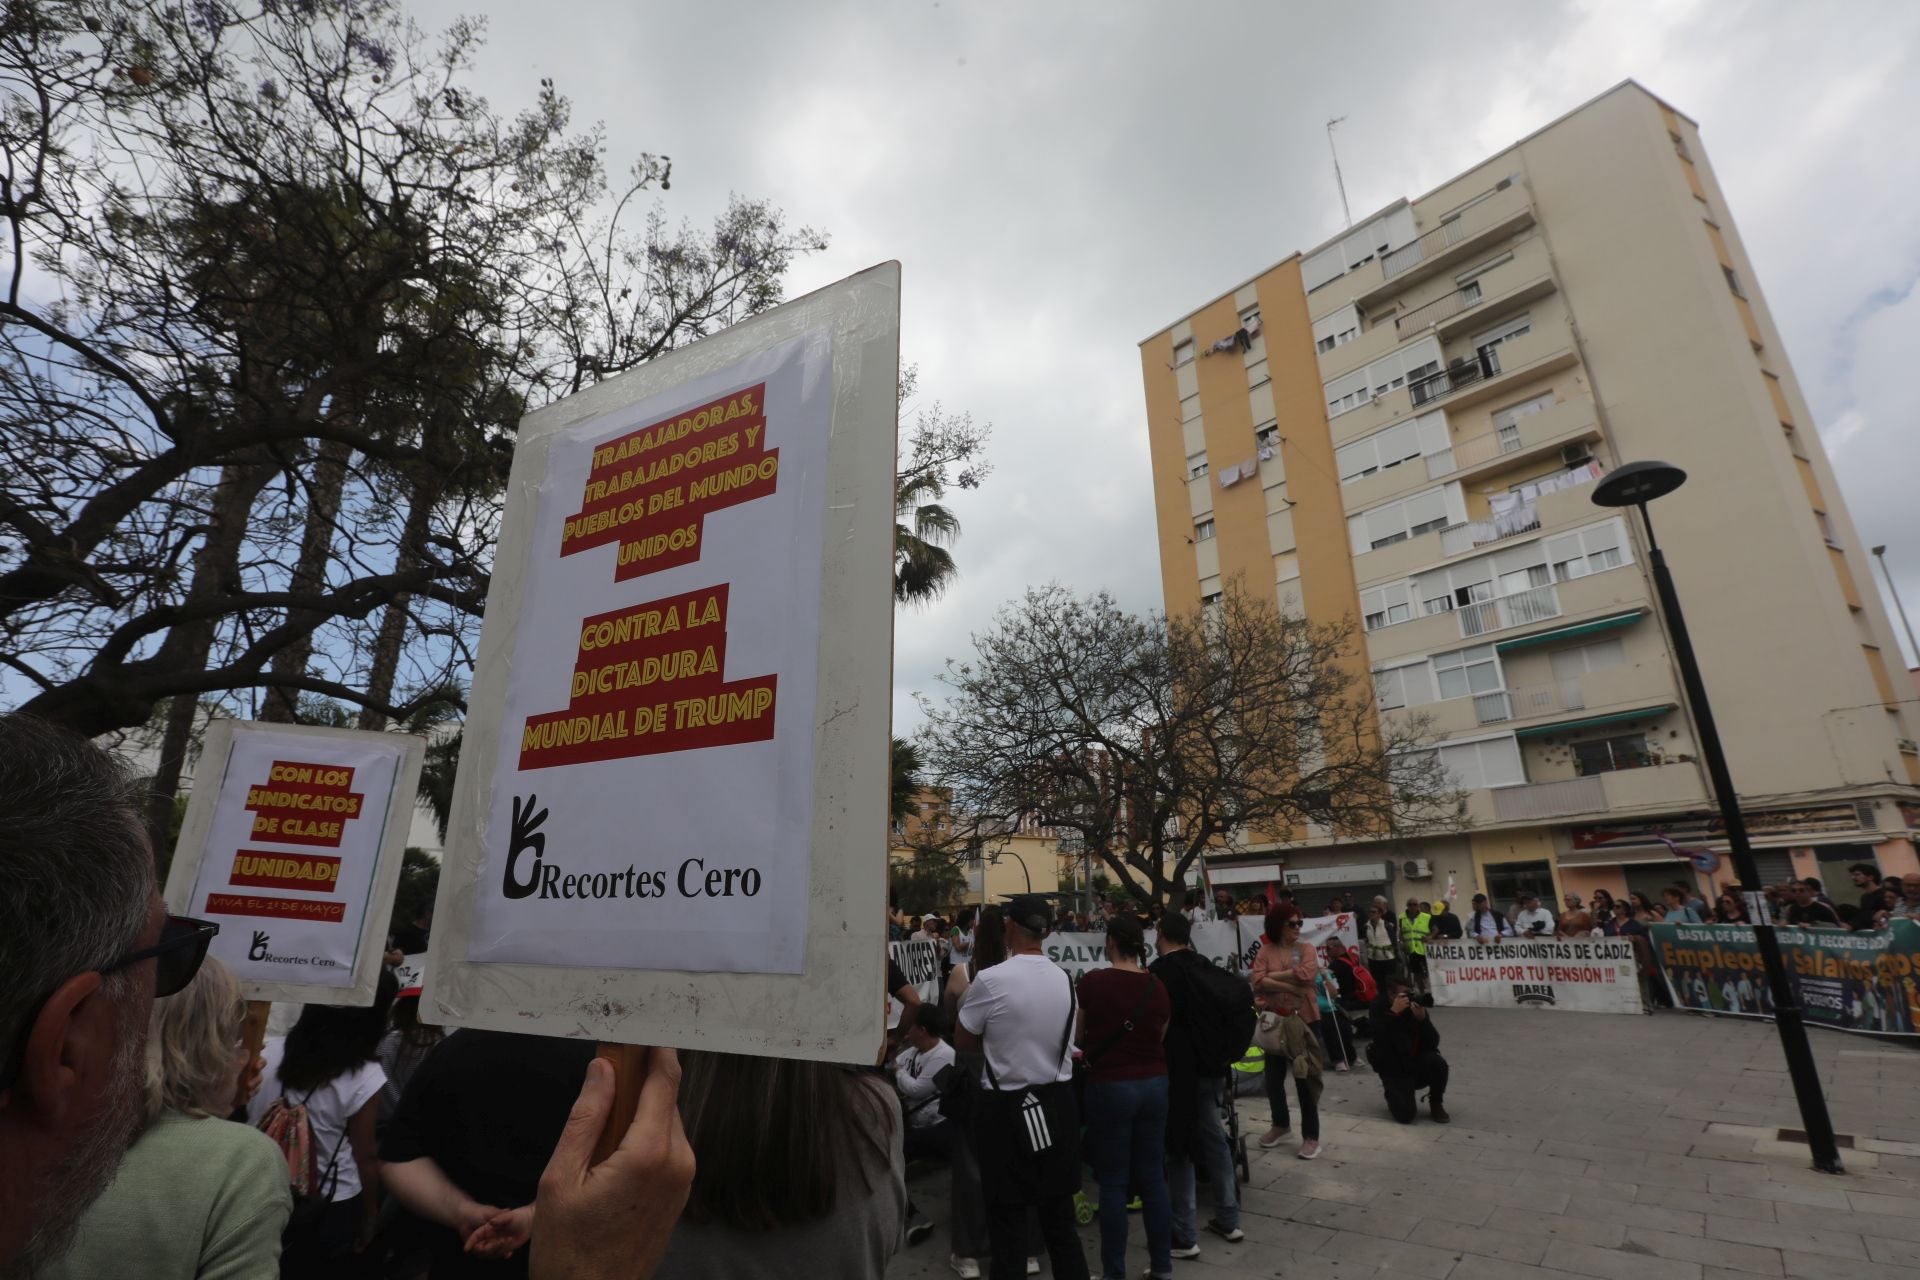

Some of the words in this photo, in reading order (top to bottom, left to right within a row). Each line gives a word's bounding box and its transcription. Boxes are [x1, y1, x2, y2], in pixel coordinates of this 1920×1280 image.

[593, 394, 757, 470] TRABAJADORAS,
[585, 436, 739, 504] TRABAJADORES
[745, 425, 761, 449] Y
[563, 499, 643, 542] PUEBLOS
[647, 488, 685, 517] DEL
[689, 456, 777, 502] MUNDO
[617, 524, 697, 566] UNIDOS
[580, 605, 680, 651] CONTRA
[687, 596, 720, 626] LA
[571, 645, 719, 698] DICTADURA
[521, 710, 628, 752] MUNDIAL
[634, 703, 667, 736] DE
[674, 687, 773, 731] TRUMP
[270, 765, 312, 783] CON
[314, 769, 349, 787] LOS
[247, 788, 358, 814] SINDICATOS
[253, 817, 277, 834] DE
[282, 818, 340, 838] CLASE
[233, 856, 340, 882] ¡UNIDAD!
[538, 863, 666, 899] Recortes
[677, 857, 761, 898] Cero
[247, 898, 264, 909] EL
[281, 901, 298, 911] DE
[1427, 945, 1466, 960] MAREA
[1468, 945, 1484, 960] DE
[1487, 943, 1571, 960] PENSIONISTAS
[1575, 944, 1592, 960] DE
[1676, 929, 1715, 942] BASTA
[1716, 929, 1731, 942] DE
[1808, 933, 1815, 946] Y
[1819, 935, 1868, 949] RECORTES
[265, 952, 309, 965] Recortes
[311, 956, 336, 967] Cero
[1242, 940, 1262, 967] MAYO
[1662, 943, 1766, 974] Empleos
[1459, 967, 1497, 981] LUCHA
[1501, 967, 1524, 981] POR
[1528, 966, 1545, 981] TU
